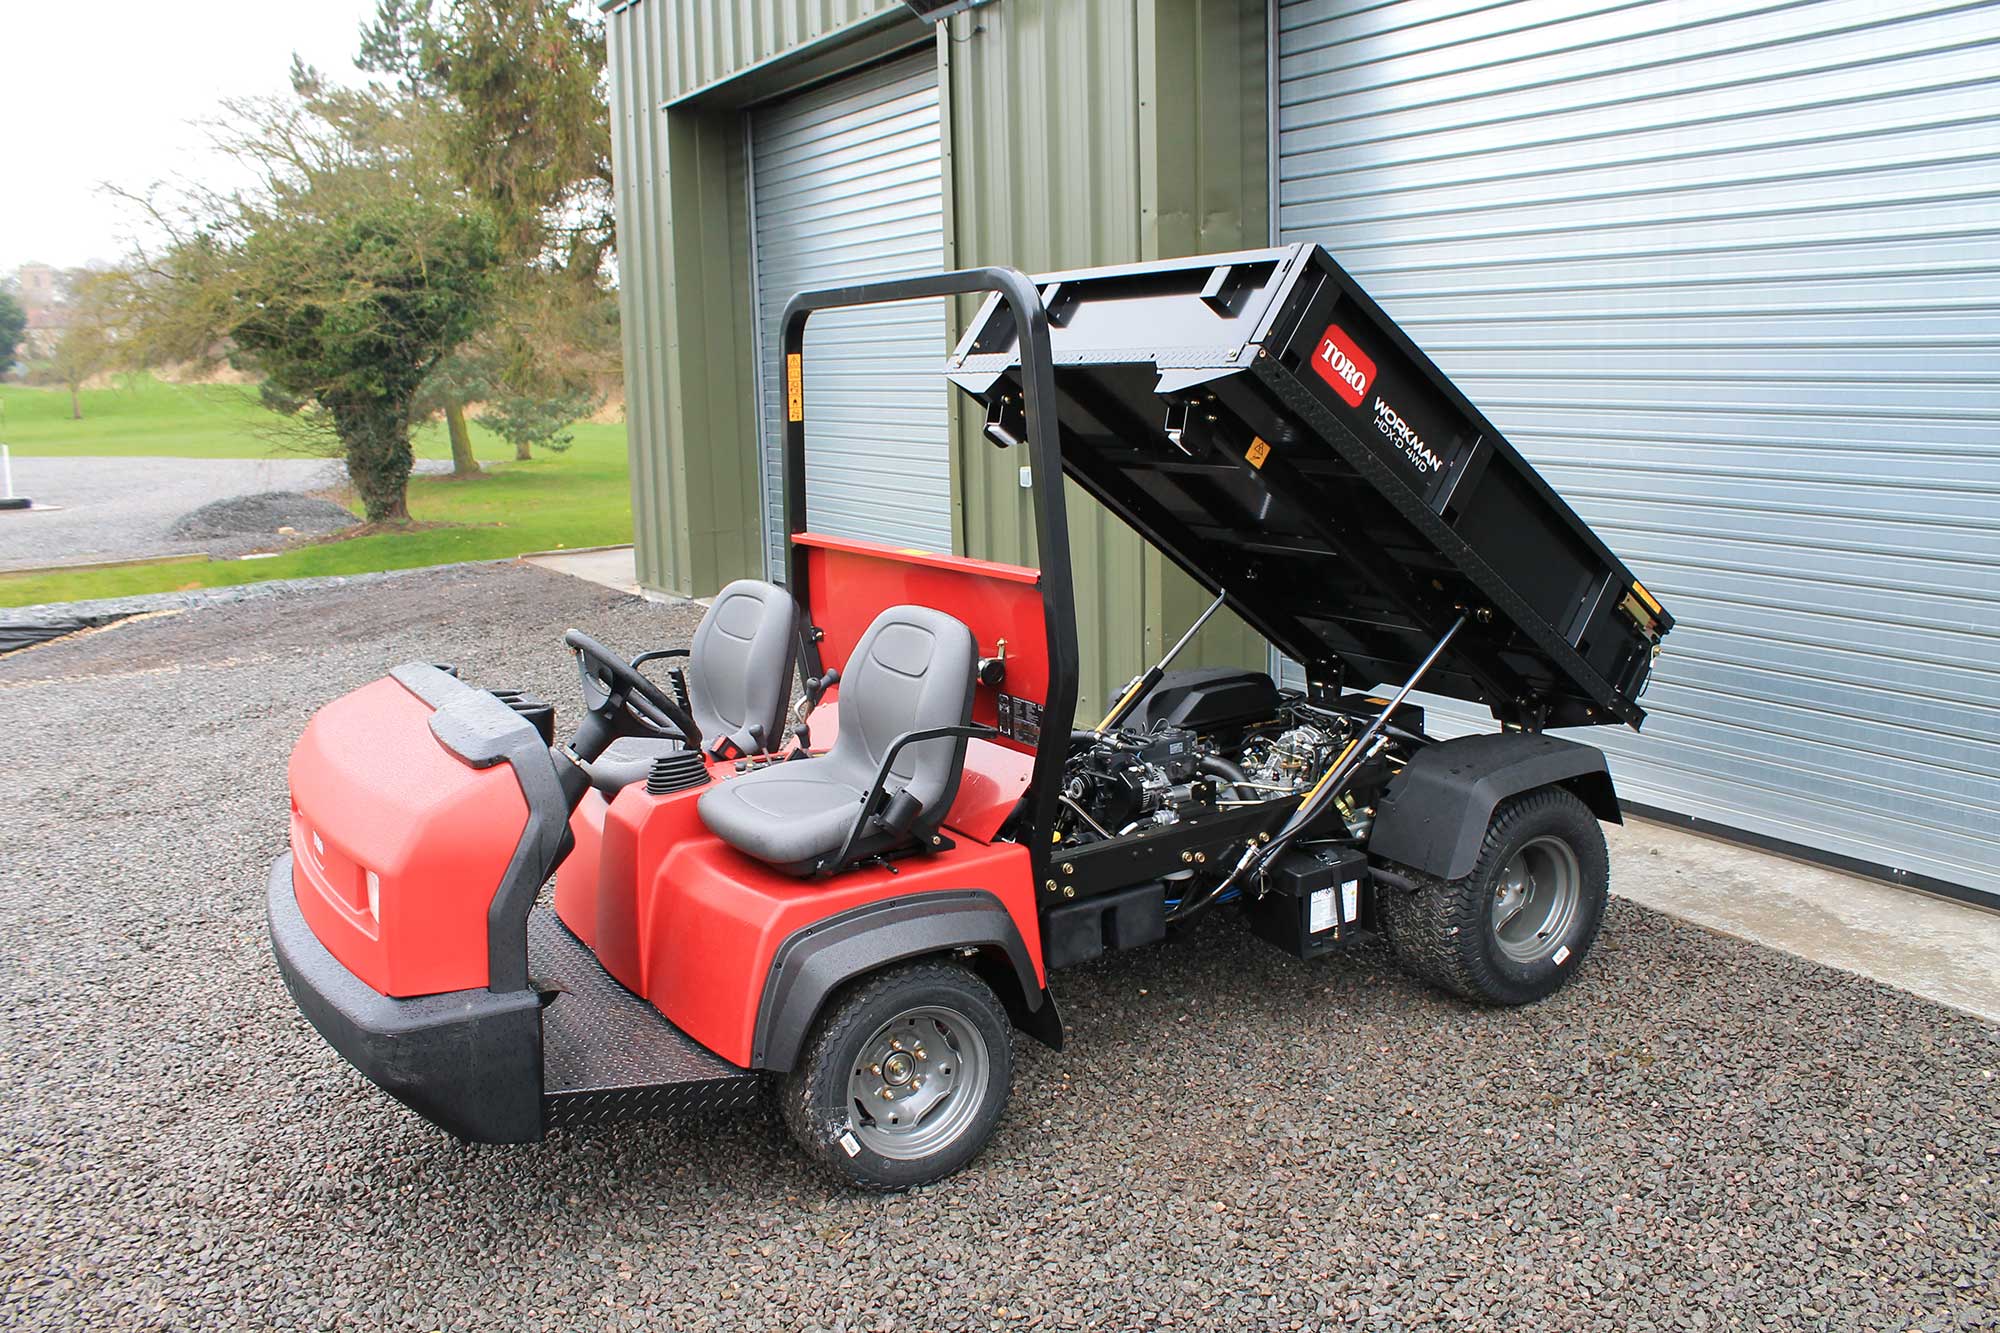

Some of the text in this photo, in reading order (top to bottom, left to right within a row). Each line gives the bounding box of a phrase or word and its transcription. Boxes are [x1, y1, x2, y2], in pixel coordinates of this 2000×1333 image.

[1373, 415, 1428, 473] HDX-D 4WD
[1374, 396, 1443, 472] WORKMAN
